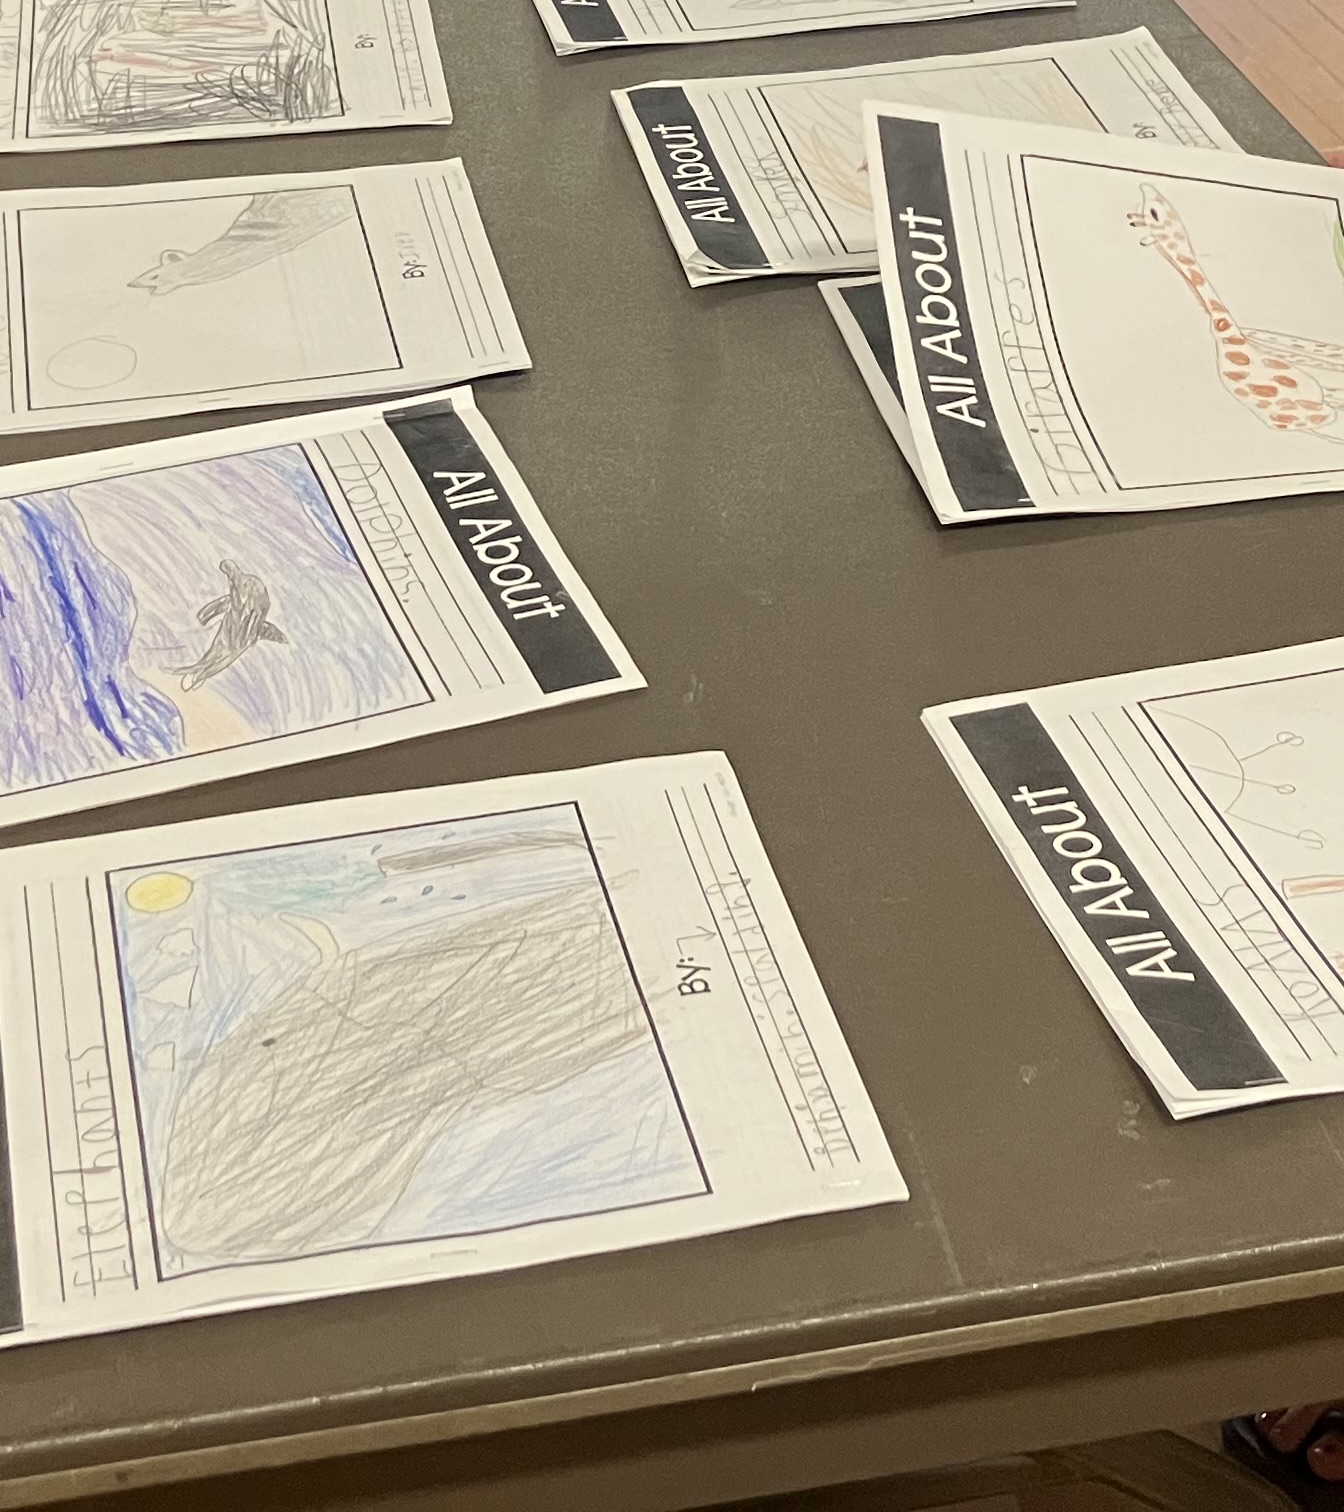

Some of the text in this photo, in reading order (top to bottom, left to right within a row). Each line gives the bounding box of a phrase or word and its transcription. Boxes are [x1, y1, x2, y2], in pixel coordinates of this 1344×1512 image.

[652, 123, 736, 223] All About
[899, 207, 987, 428] All About
[433, 471, 566, 621] All About
[1011, 785, 1197, 982] All About
[676, 956, 712, 997] By:
